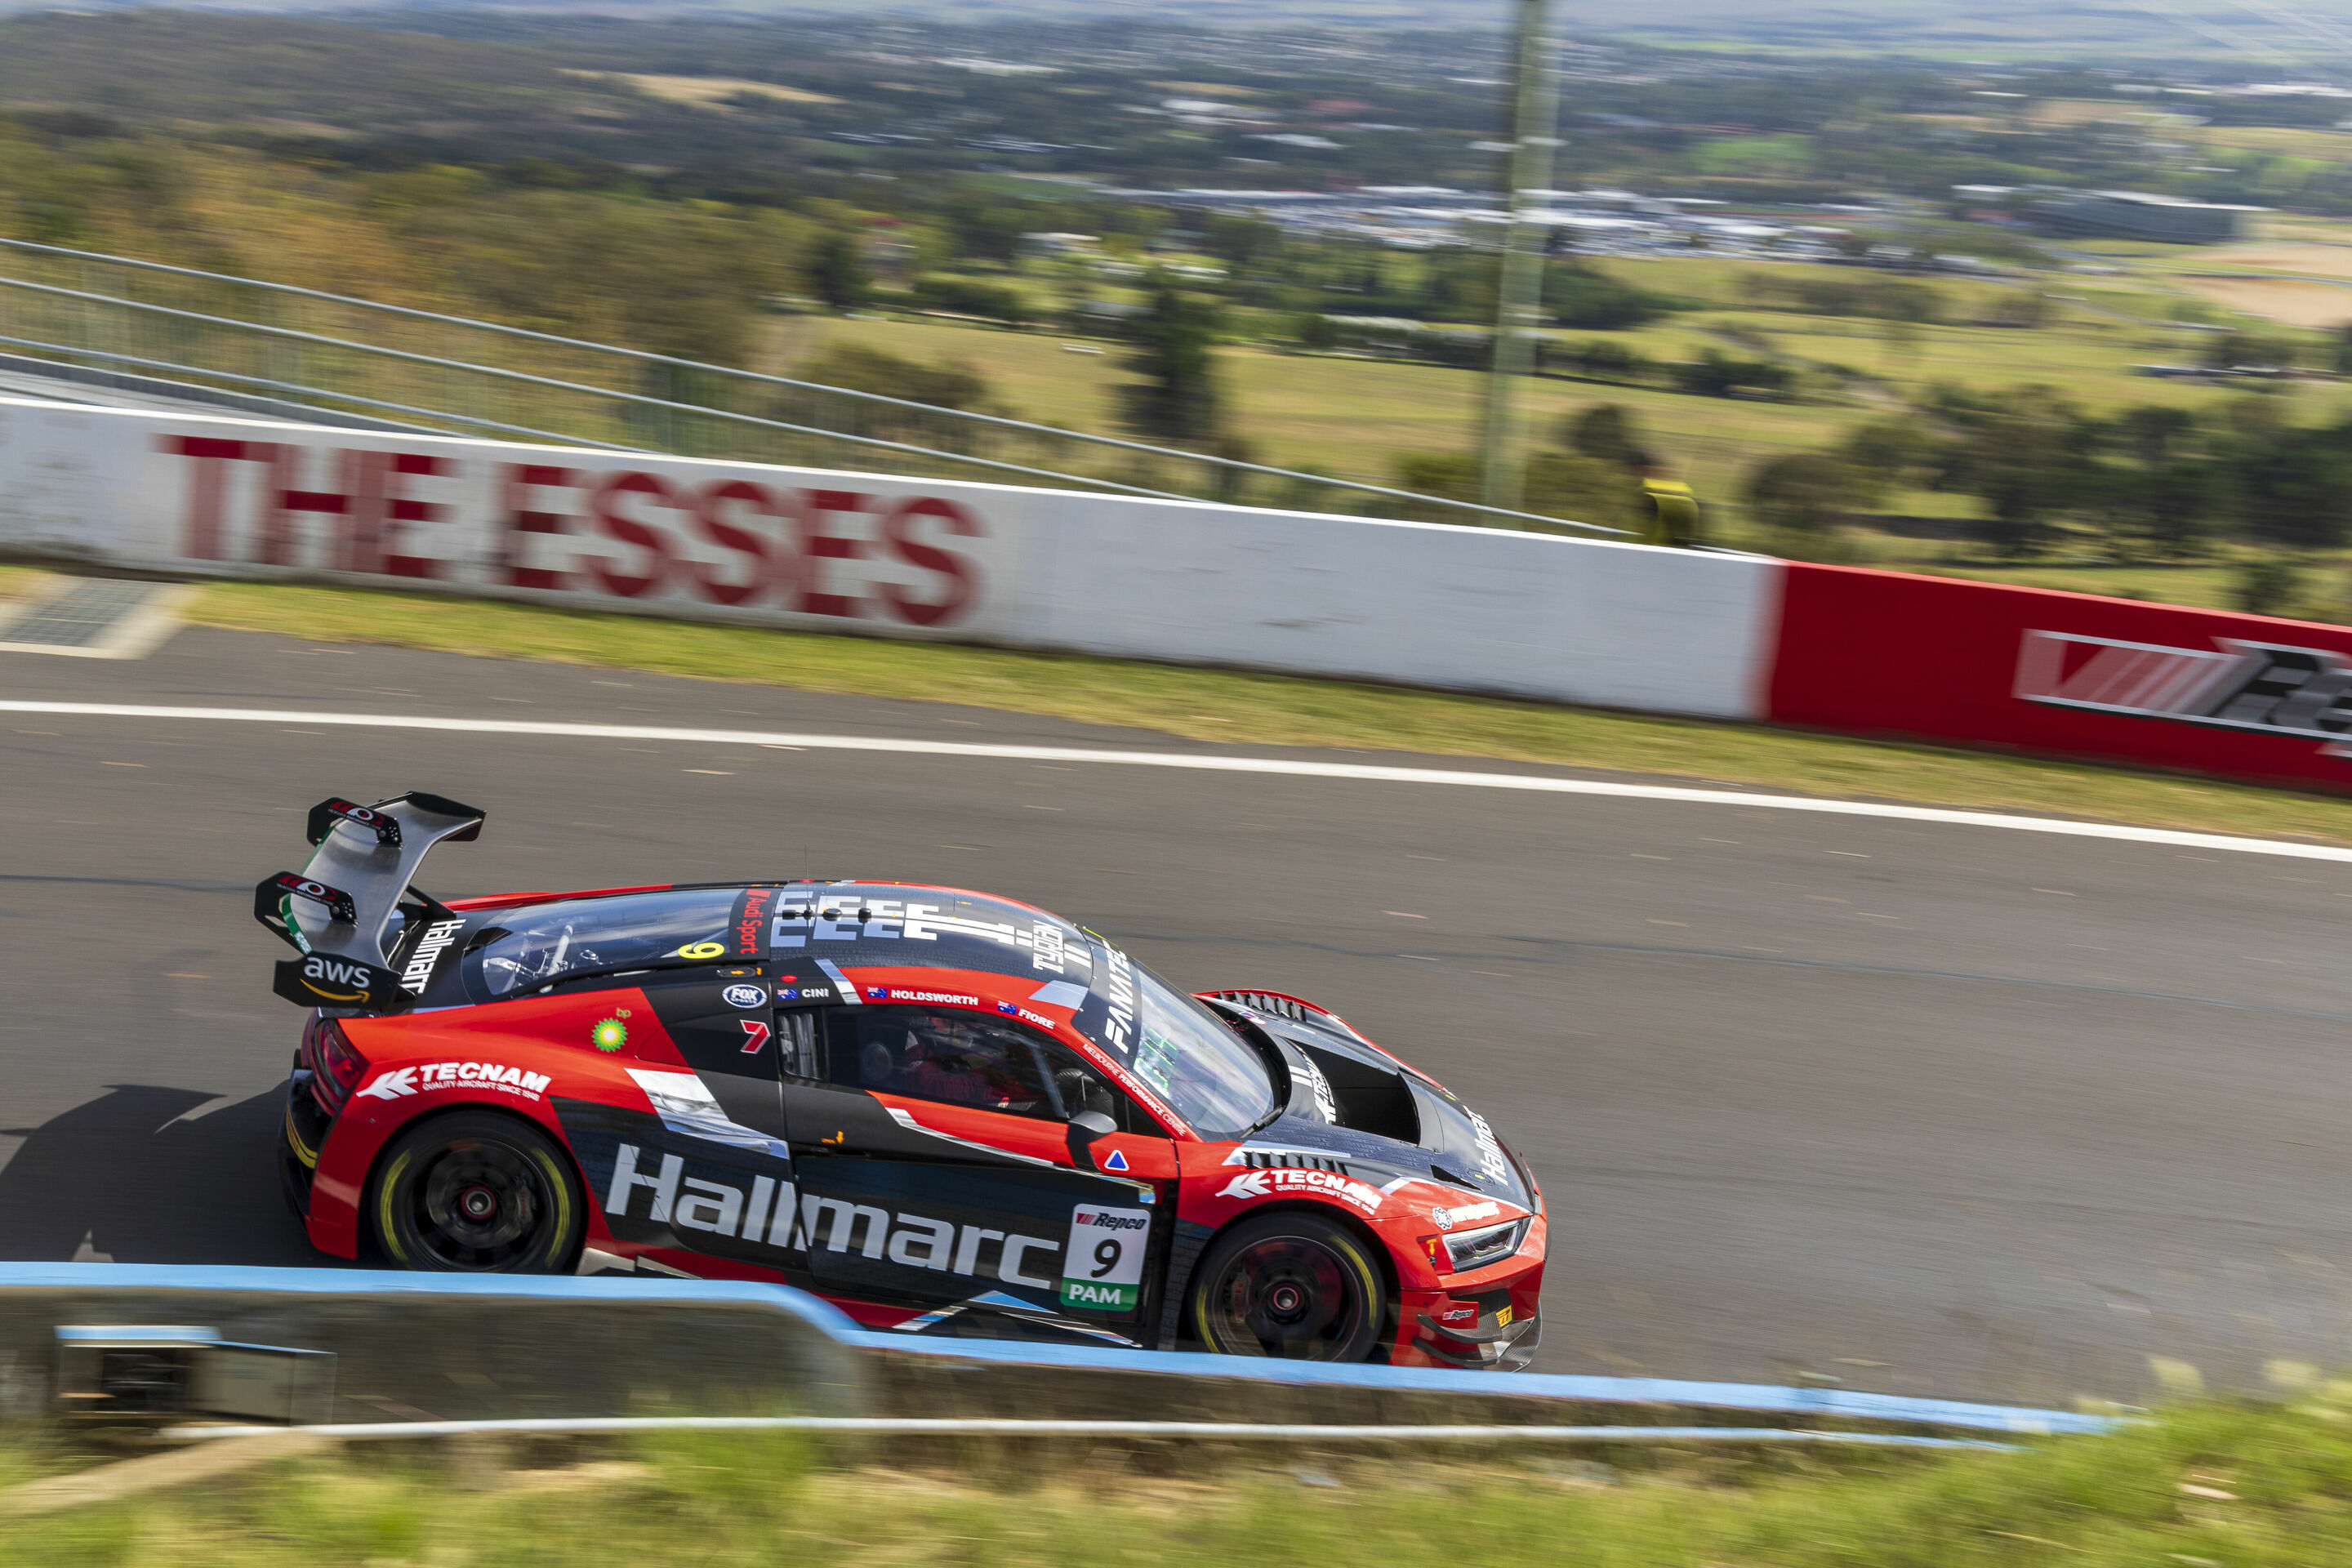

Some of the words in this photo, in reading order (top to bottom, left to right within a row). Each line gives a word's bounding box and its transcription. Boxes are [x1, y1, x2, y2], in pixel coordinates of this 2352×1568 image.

[162, 434, 452, 578] THE
[500, 461, 990, 628] ESSES
[743, 897, 767, 918] Audi
[736, 920, 763, 955] Sport
[303, 956, 371, 989] aws
[731, 987, 759, 1001] FOX
[890, 989, 979, 1006] HOLDSWORTH
[1102, 939, 1134, 1054] FANATEC
[616, 1006, 632, 1019] bp
[1018, 1008, 1056, 1030] FIORE
[419, 1062, 552, 1094] TECNAM
[422, 1080, 457, 1092] QUALITY
[457, 1080, 497, 1090] AIRCRAFT
[496, 1081, 523, 1096] SINCE
[1082, 1043, 1120, 1076] MELBOURNE
[1117, 1073, 1165, 1116] PERFORMANCE
[1161, 1113, 1187, 1137] CENTRE
[1270, 1169, 1383, 1209] TECNAM
[1276, 1183, 1307, 1192] QUALITY
[1306, 1184, 1342, 1199] AIRCRAFT
[1341, 1193, 1361, 1208] SINCE
[605, 1143, 1060, 1290] Hallmarc
[1093, 1212, 1147, 1231] Repco
[1090, 1238, 1122, 1278] 9
[1067, 1284, 1122, 1305] PAM
